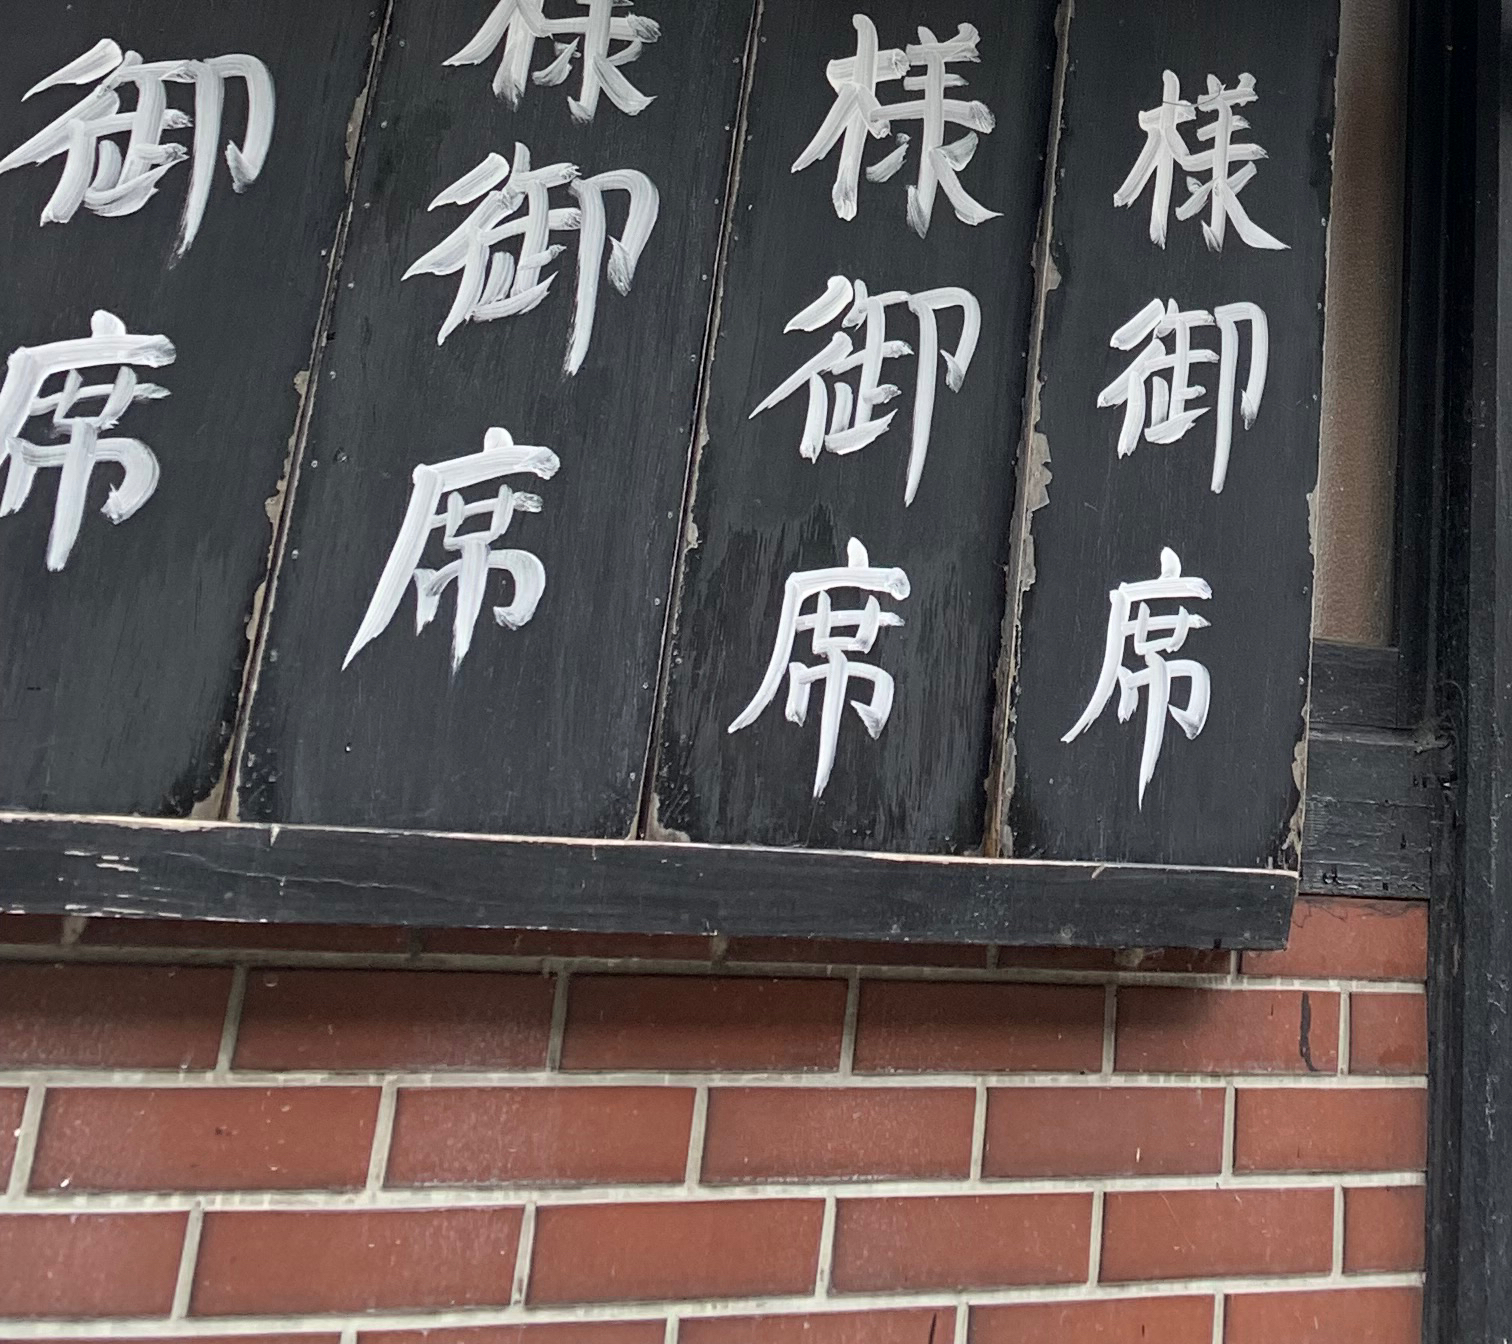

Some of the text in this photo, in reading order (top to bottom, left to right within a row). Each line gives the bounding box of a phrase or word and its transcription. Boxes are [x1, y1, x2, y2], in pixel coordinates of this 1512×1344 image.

[728, 13, 1004, 799] 様御席
[1061, 69, 1291, 811] 様御席
